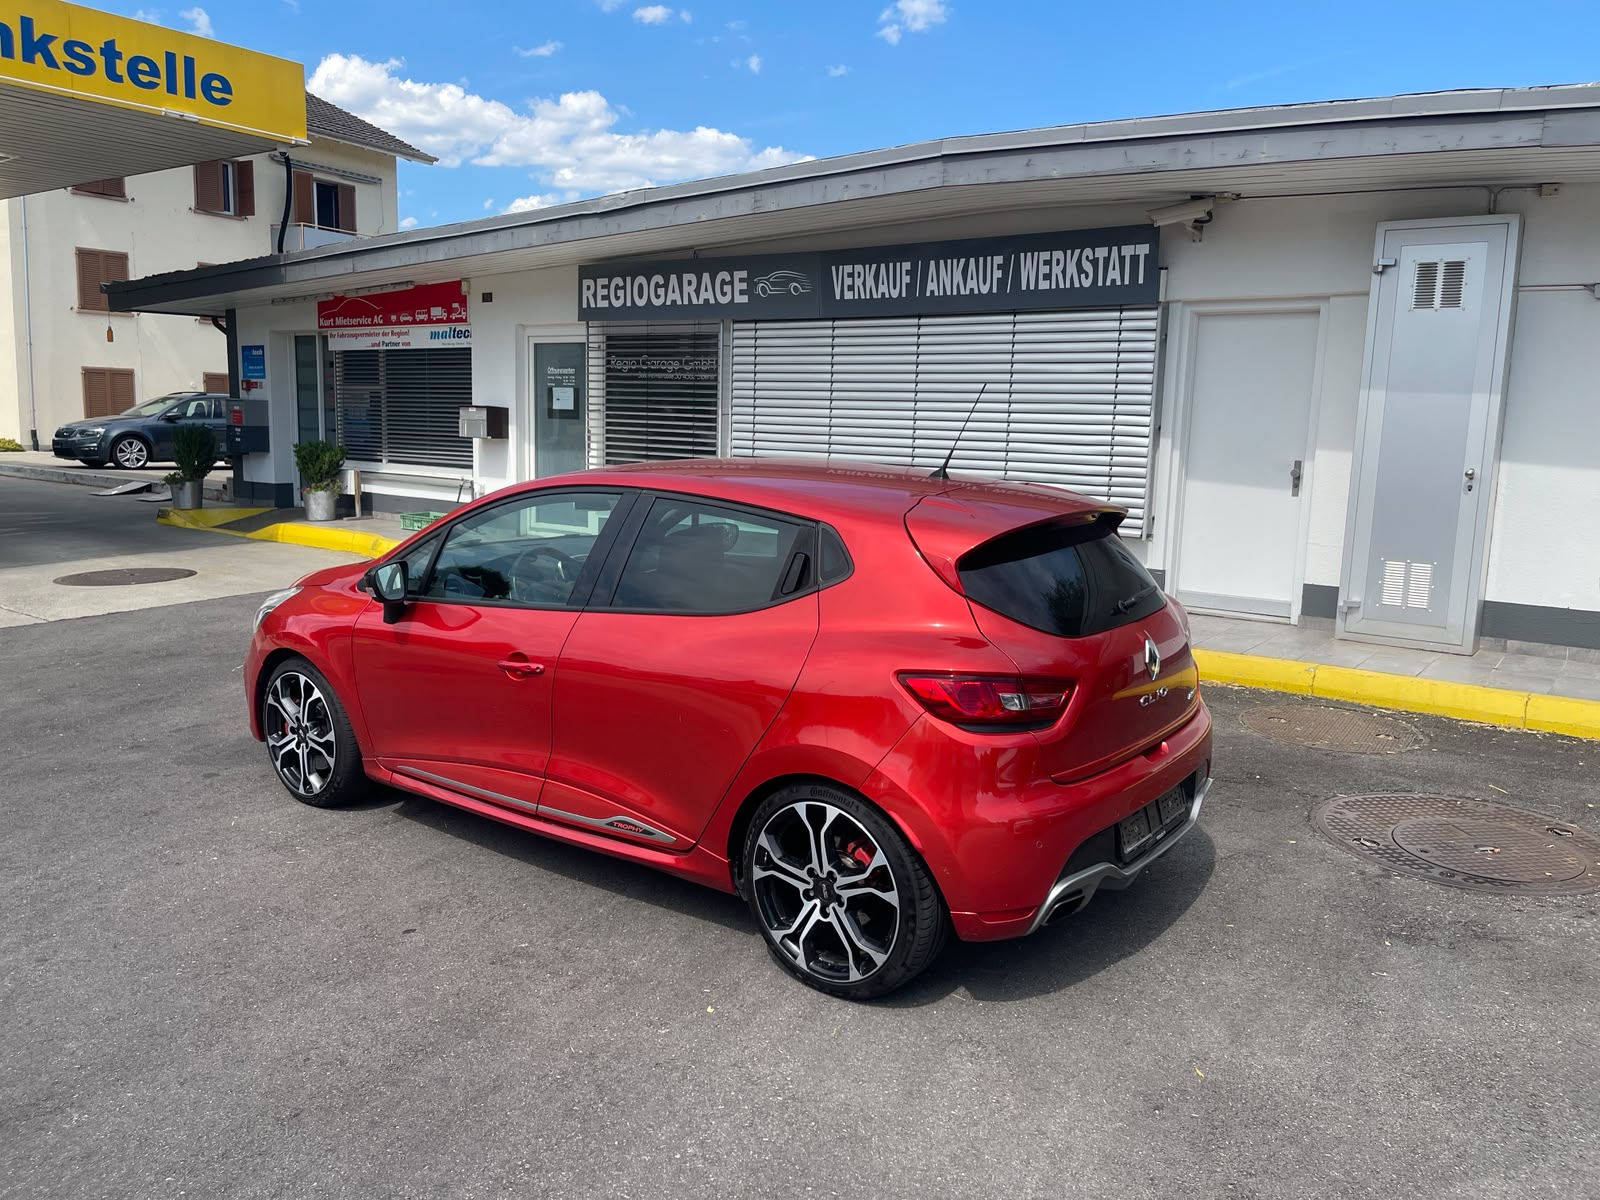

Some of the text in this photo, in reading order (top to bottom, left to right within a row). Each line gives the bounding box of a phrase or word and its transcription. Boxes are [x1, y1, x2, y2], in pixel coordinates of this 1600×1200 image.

[831, 261, 911, 300] VERKAUF
[925, 255, 1004, 297] ANKAUF
[1020, 243, 1150, 291] WERKSTATT
[581, 270, 749, 309] REGIOGARAGE
[319, 314, 384, 327] Kurt Mietservice AG
[390, 329, 410, 339] Region!
[381, 340, 400, 348] Partner
[610, 354, 716, 373] Regio Garage GmbH
[612, 821, 645, 833] TROPHY
